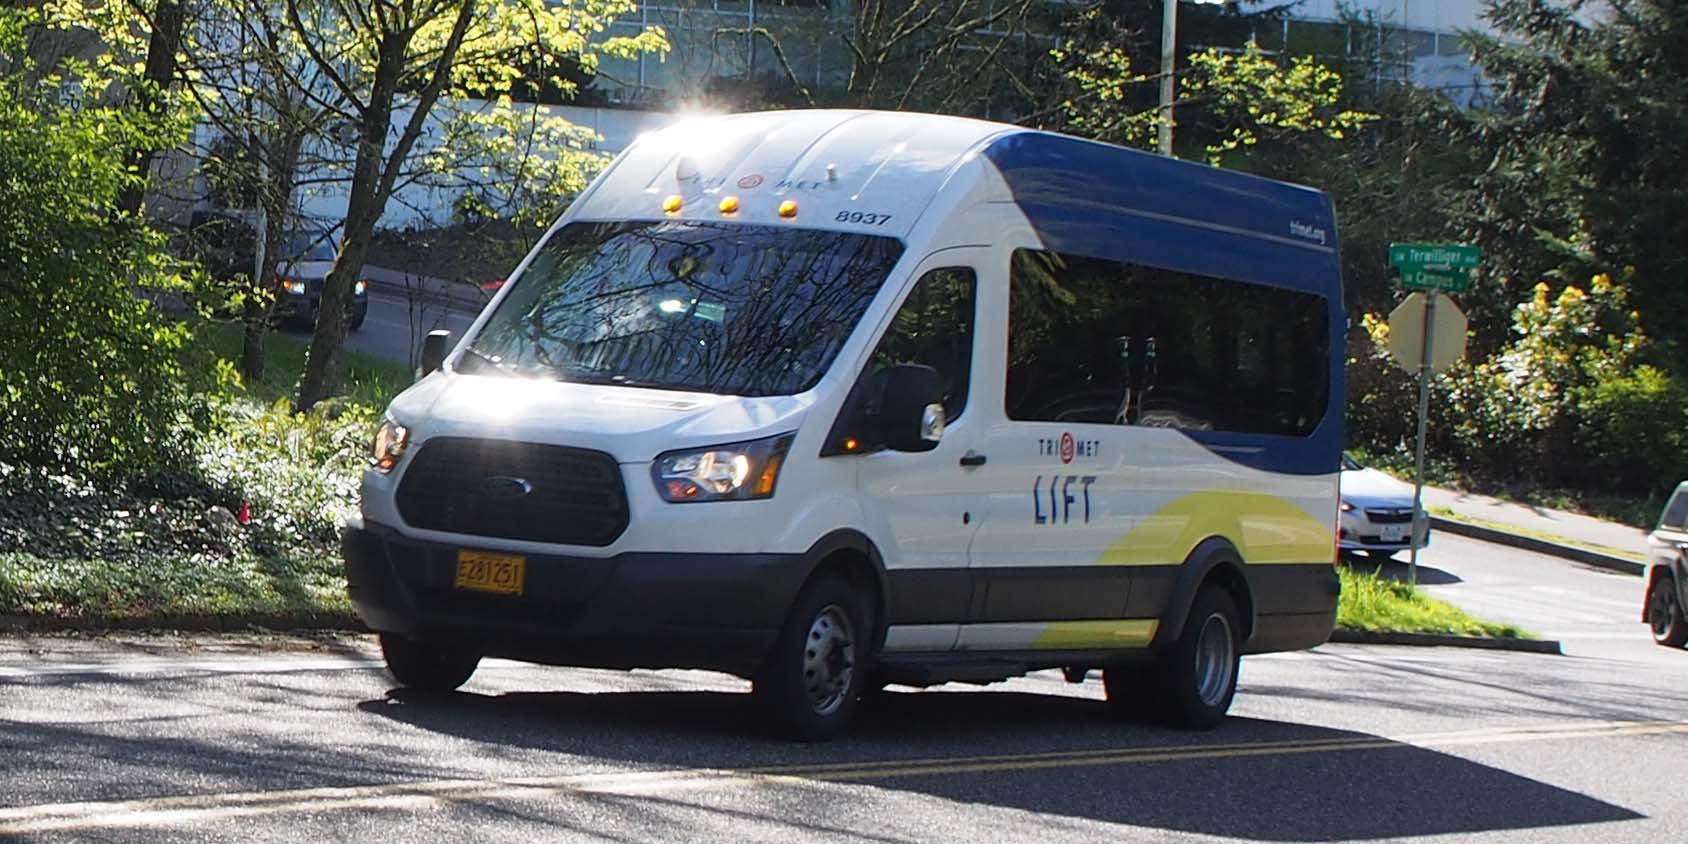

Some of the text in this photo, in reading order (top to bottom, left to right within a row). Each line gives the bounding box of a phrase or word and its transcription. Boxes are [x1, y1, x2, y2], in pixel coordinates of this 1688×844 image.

[835, 210, 892, 226] 8937
[1410, 249, 1461, 267] Terwilliger
[1416, 272, 1454, 288] Campus
[1038, 439, 1100, 457] TRI MET
[1033, 475, 1097, 525] LIFT
[459, 559, 521, 586] E281251
